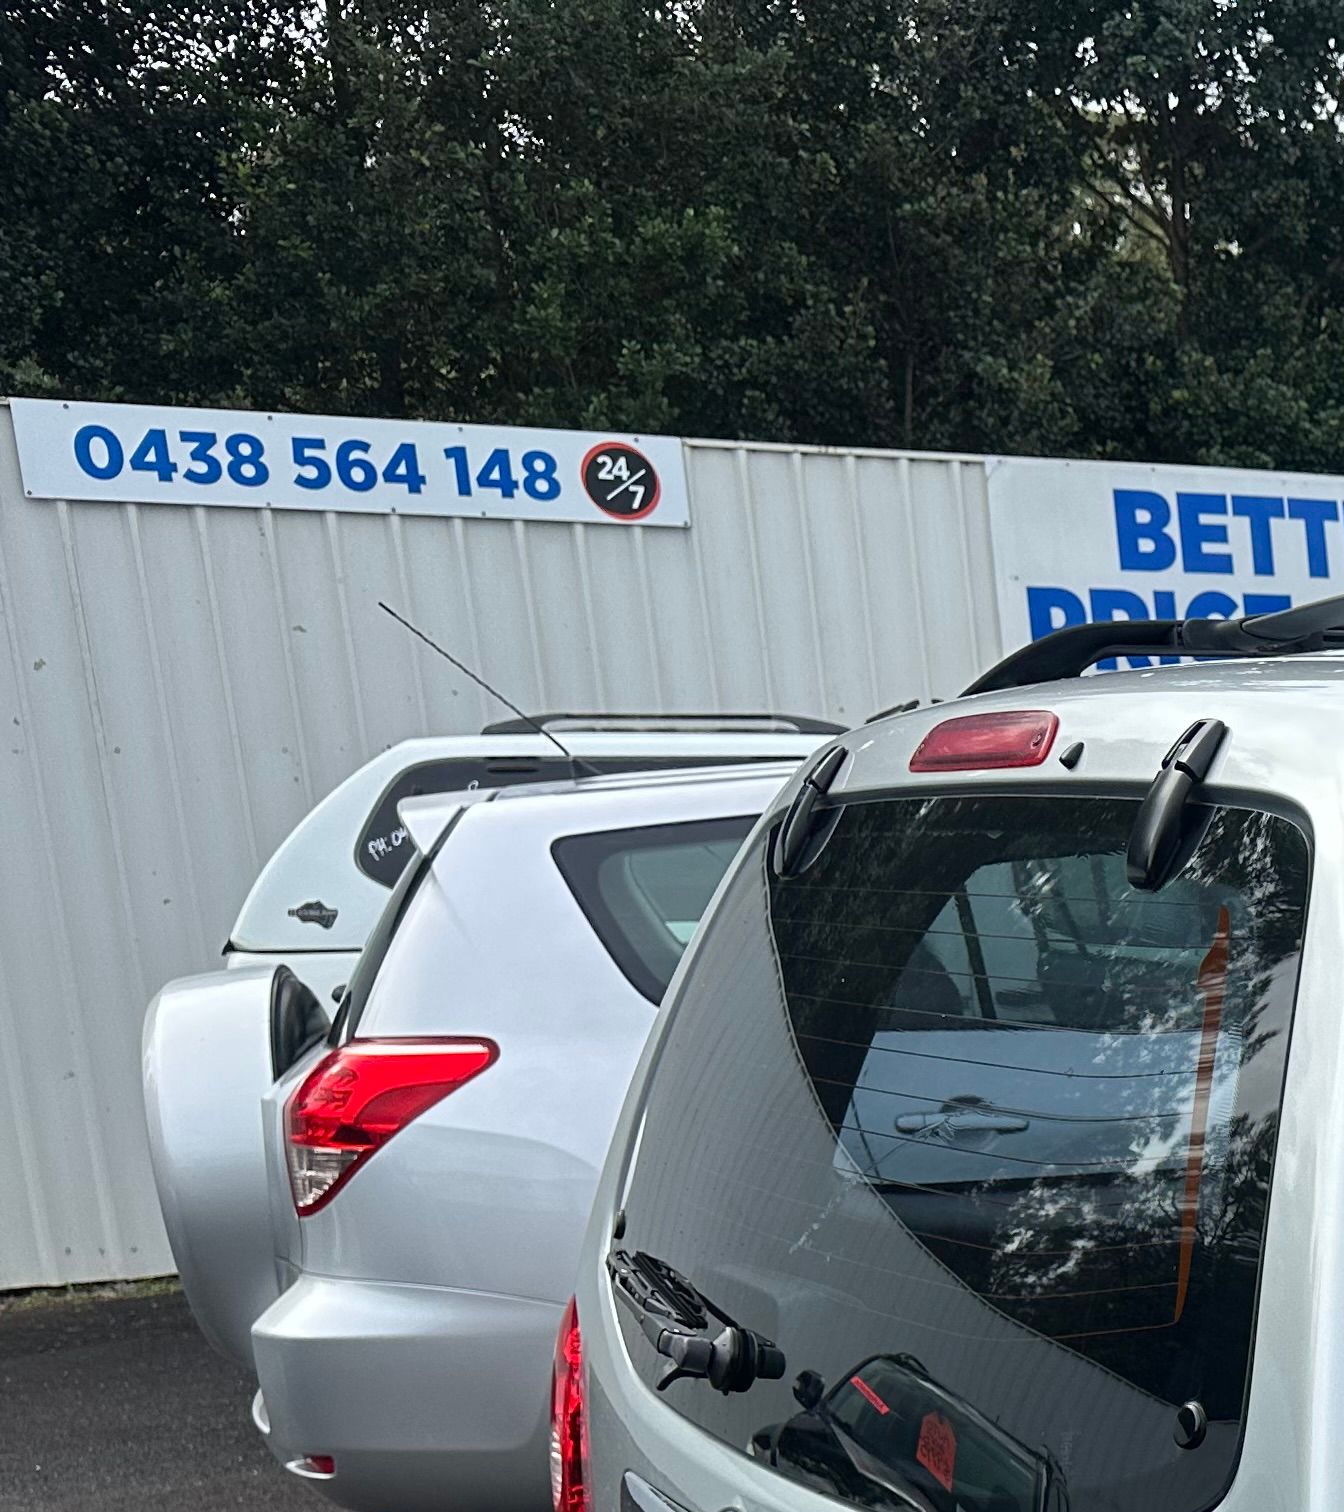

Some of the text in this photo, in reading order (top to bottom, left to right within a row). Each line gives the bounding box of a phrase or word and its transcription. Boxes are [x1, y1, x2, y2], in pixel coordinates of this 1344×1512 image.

[74, 425, 561, 501] 0438 564 148
[596, 455, 646, 510] 24/7
